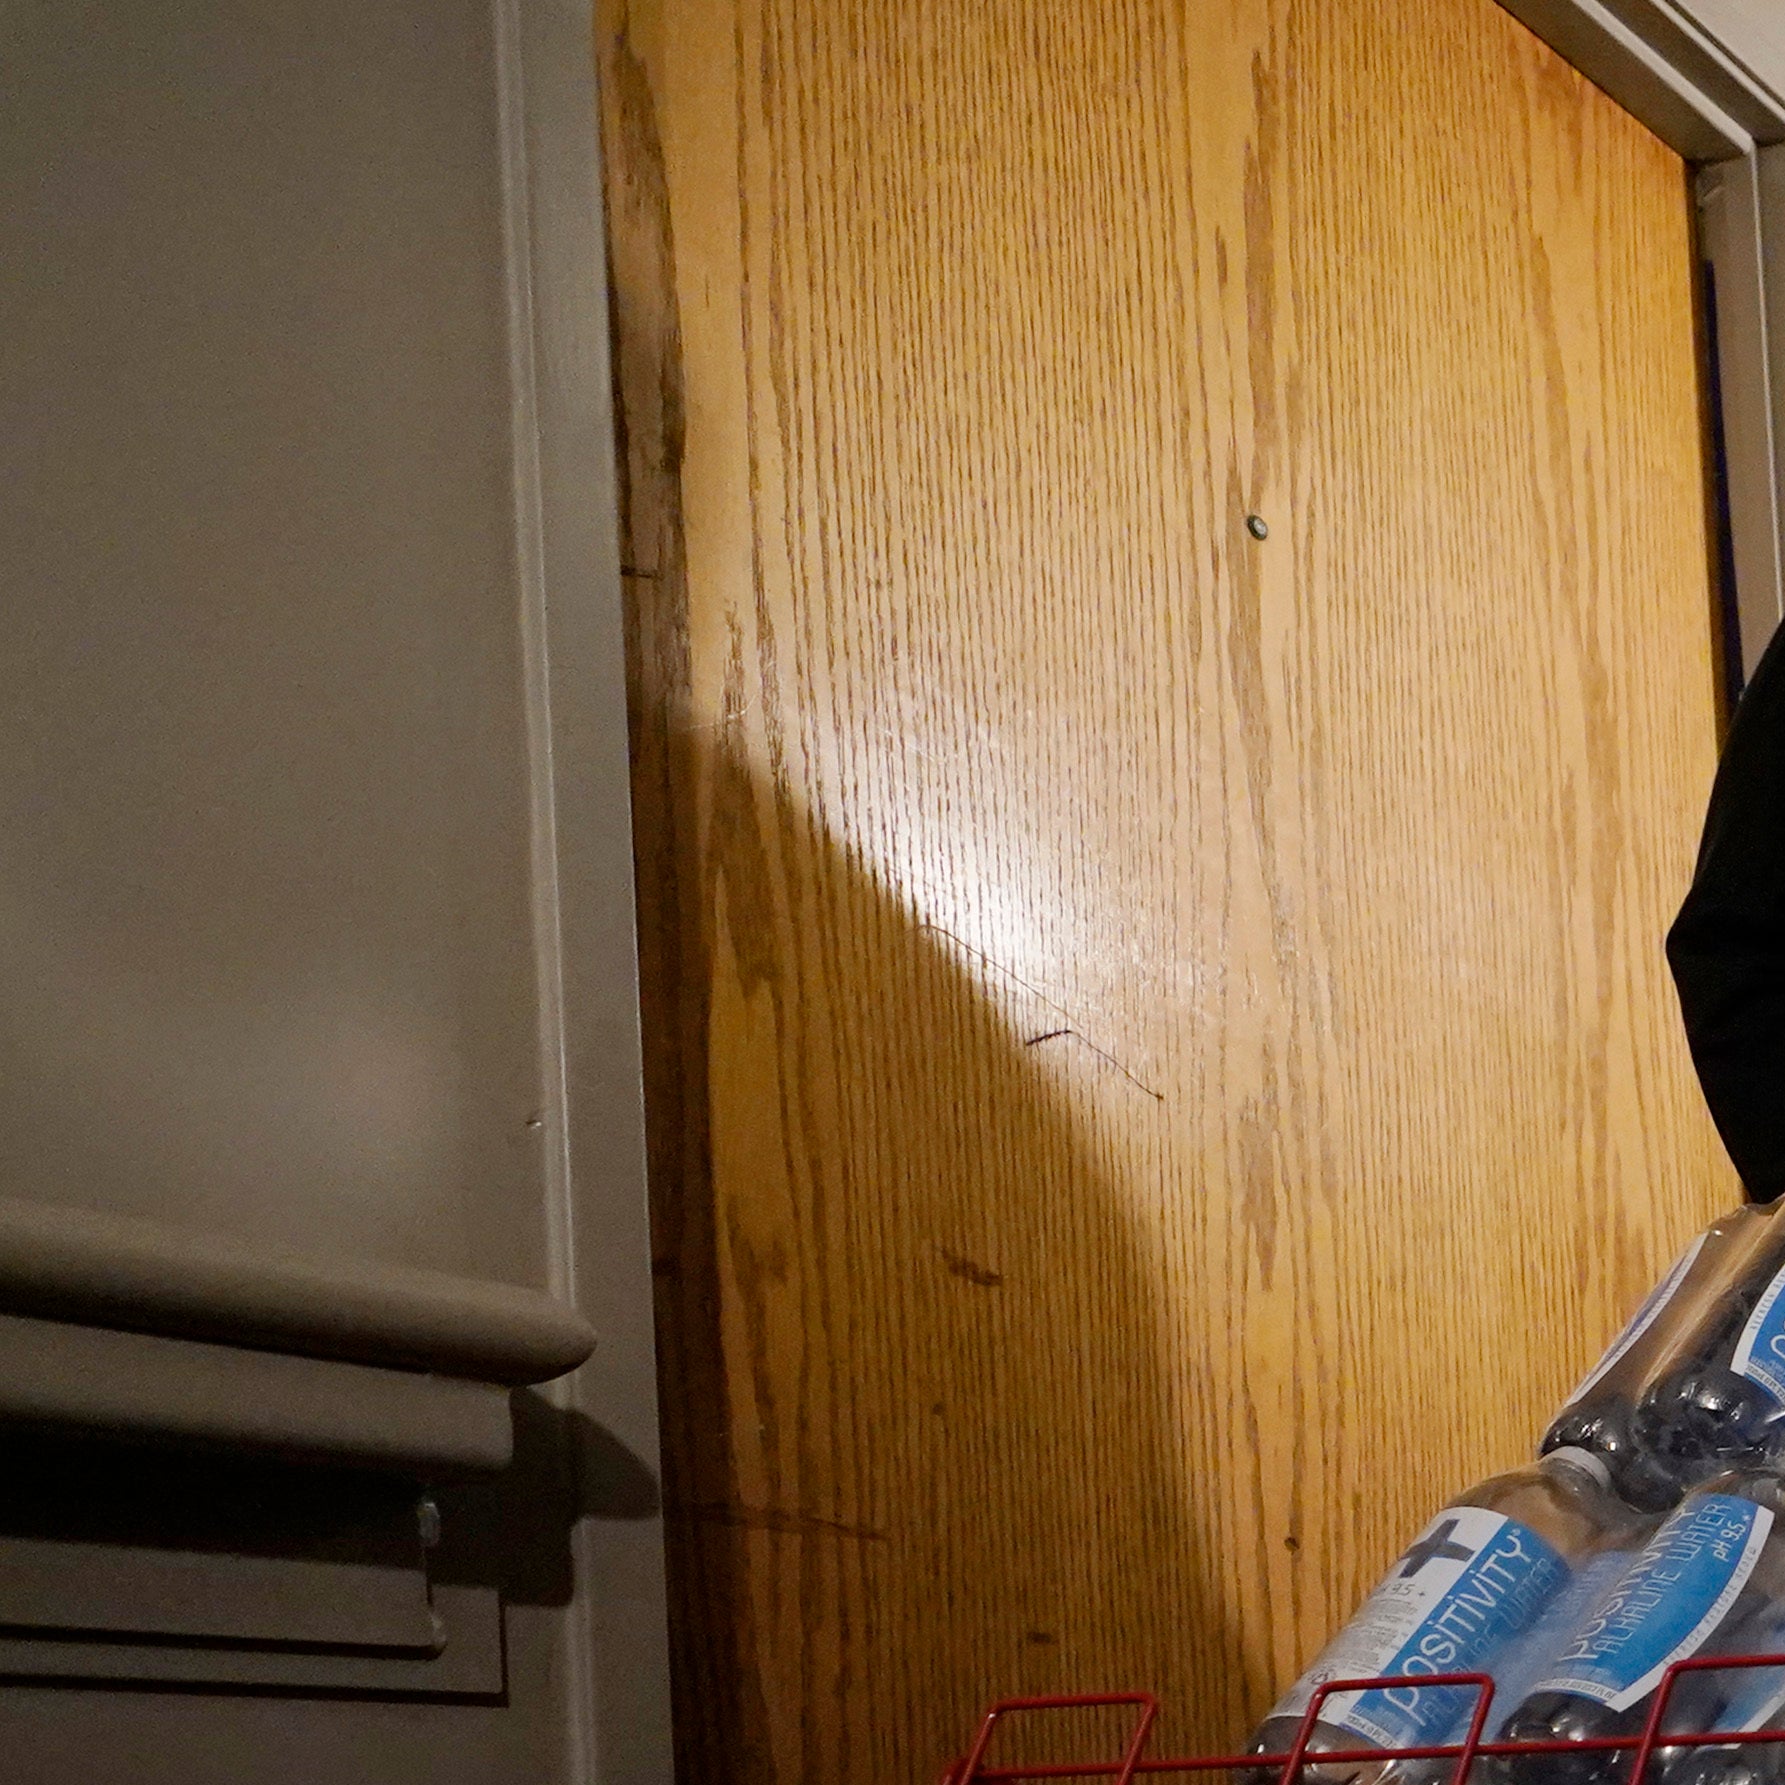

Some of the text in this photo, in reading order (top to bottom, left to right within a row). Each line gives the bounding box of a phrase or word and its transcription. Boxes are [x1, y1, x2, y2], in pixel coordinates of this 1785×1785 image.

[1592, 1571, 1681, 1654] ALKALINE
[1667, 1503, 1731, 1561] WATER
[1710, 1540, 1731, 1562] pH
